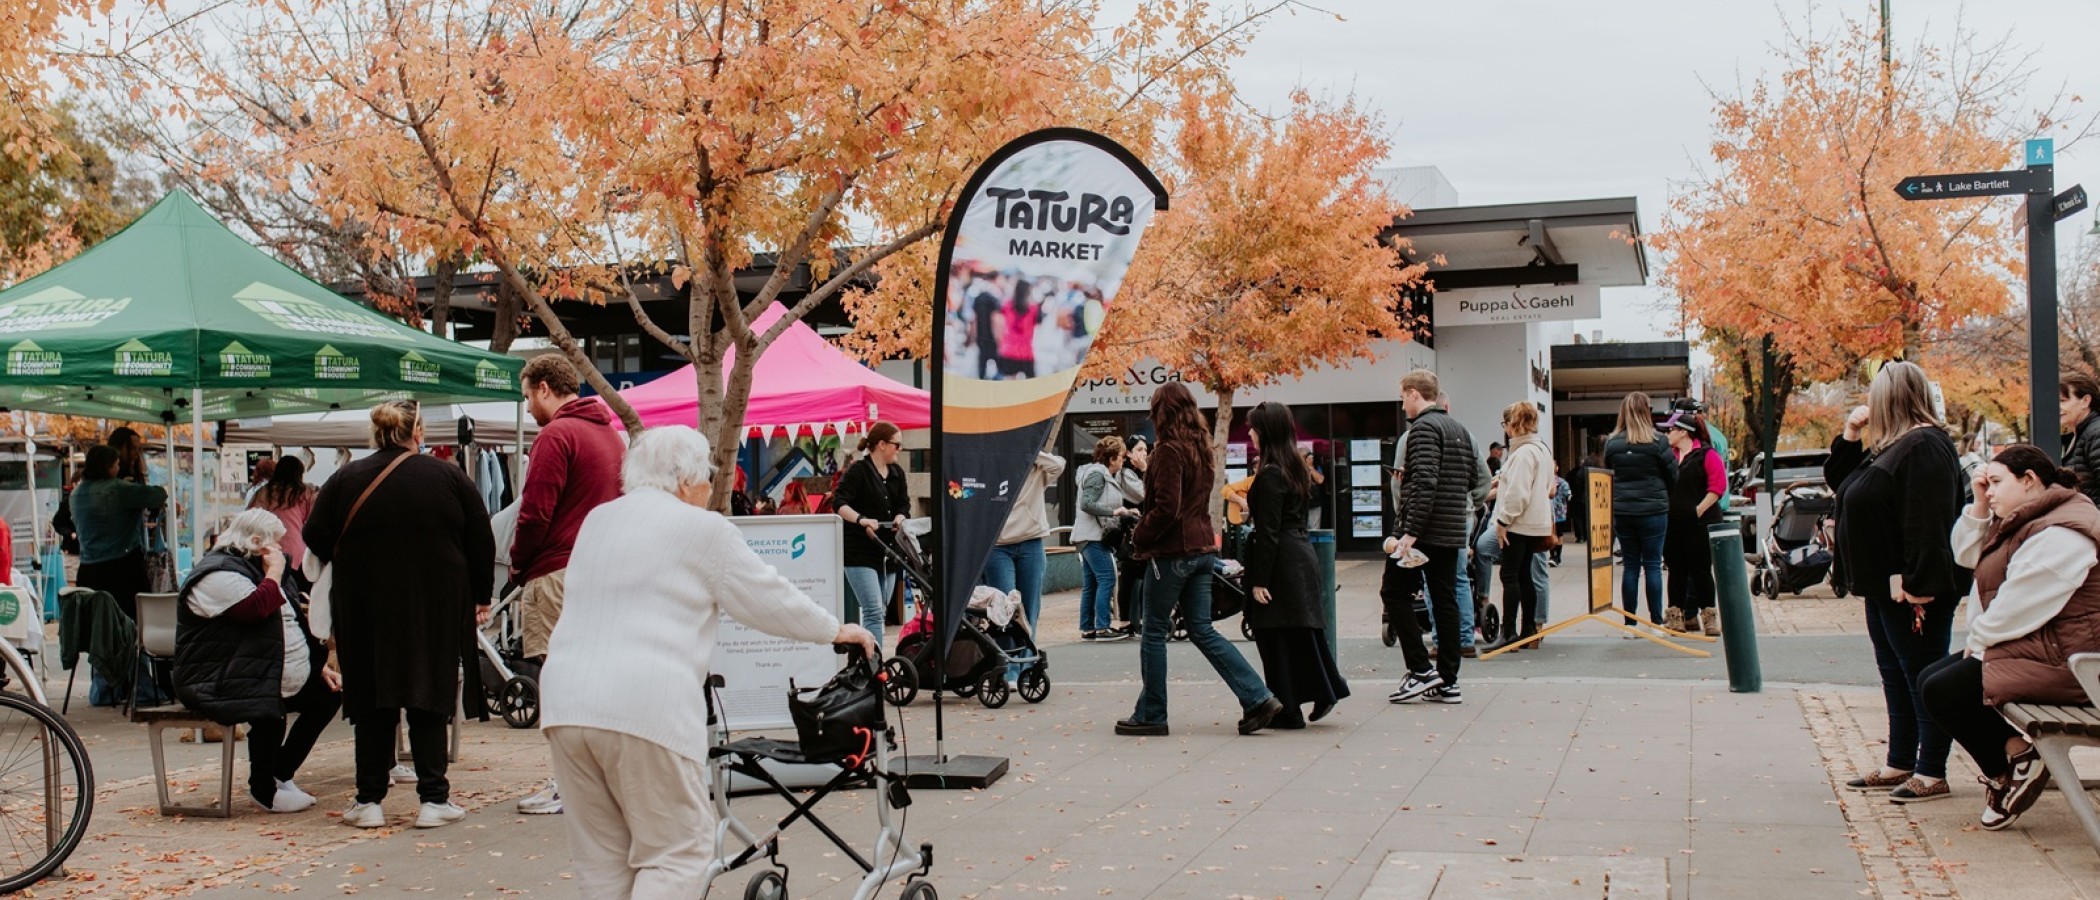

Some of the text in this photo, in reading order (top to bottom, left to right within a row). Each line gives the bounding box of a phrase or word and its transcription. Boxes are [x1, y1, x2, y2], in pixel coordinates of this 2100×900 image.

[1948, 180, 2010, 192] Lake Bartlett
[986, 187, 1135, 236] TATURA
[1008, 238, 1104, 261] MARKET
[1460, 290, 1574, 314] Puppa & Gaehl
[23, 351, 62, 361] TATURA
[131, 351, 172, 362] TATURA
[235, 354, 271, 364] TATURA
[327, 356, 359, 366] TATURA
[1090, 397, 1121, 405] REAL
[746, 539, 788, 547] GREATER
[797, 577, 826, 585] conducting
